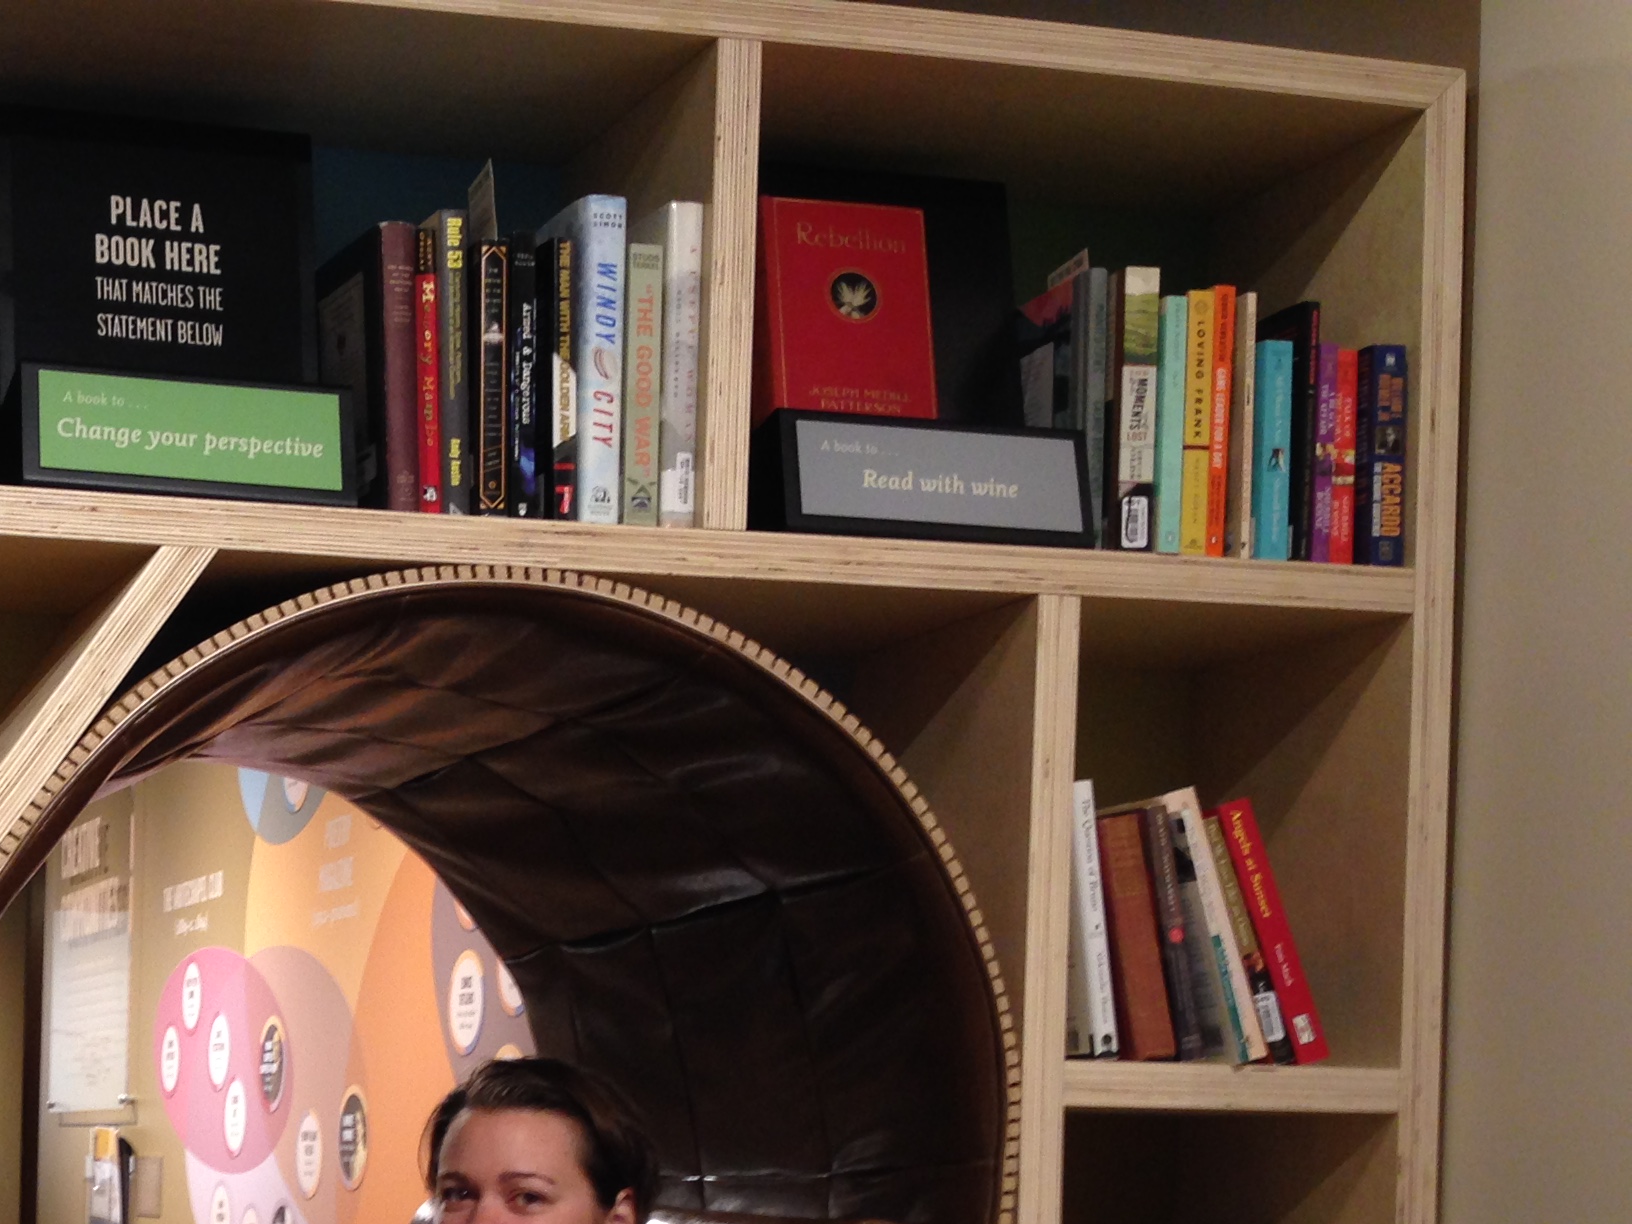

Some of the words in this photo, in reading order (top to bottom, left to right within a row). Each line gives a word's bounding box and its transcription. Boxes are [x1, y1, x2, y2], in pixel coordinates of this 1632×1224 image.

[110, 195, 182, 231] PLACE
[191, 203, 204, 233] A
[446, 217, 463, 246] Rule
[95, 233, 156, 269] BOOK
[165, 240, 221, 275] HERE
[559, 242, 571, 267] THE
[795, 221, 907, 254] Rebellion
[447, 251, 463, 269] 53
[95, 276, 128, 302] THAT
[132, 281, 194, 309] MATCHES
[197, 286, 223, 311] THE
[595, 262, 618, 344] WINDY
[636, 285, 653, 337] "THE
[97, 313, 173, 342] STATEMENT
[177, 320, 223, 347] BELOW
[421, 280, 436, 365] Memory
[521, 302, 533, 338] Armed
[559, 301, 571, 332] WITH
[521, 346, 533, 355] &
[559, 335, 571, 358] THE
[1196, 321, 1206, 380] LOVING
[521, 362, 533, 425] Dangerous
[559, 362, 571, 413] GOLDEN
[635, 345, 653, 406] GOOD
[63, 391, 73, 403] A
[77, 391, 108, 406] book
[423, 376, 439, 447] Mambo
[820, 399, 901, 414] PATTERSON
[1129, 378, 1148, 431] MOMENTS
[1193, 389, 1203, 438] FRANK
[57, 417, 142, 448] Change
[145, 428, 198, 450] your
[203, 431, 324, 459] perspective
[592, 390, 615, 448] CITY
[633, 417, 652, 477] WAR"
[821, 440, 830, 451] A
[833, 441, 862, 454] book
[450, 460, 462, 486] Austin
[863, 469, 913, 492] Read
[920, 474, 965, 495] with
[972, 479, 1018, 499] wine
[1381, 462, 1403, 537] ACCARDO
[1229, 809, 1254, 856] Angels
[1245, 857, 1257, 871] at
[1250, 872, 1272, 918] Sunset
